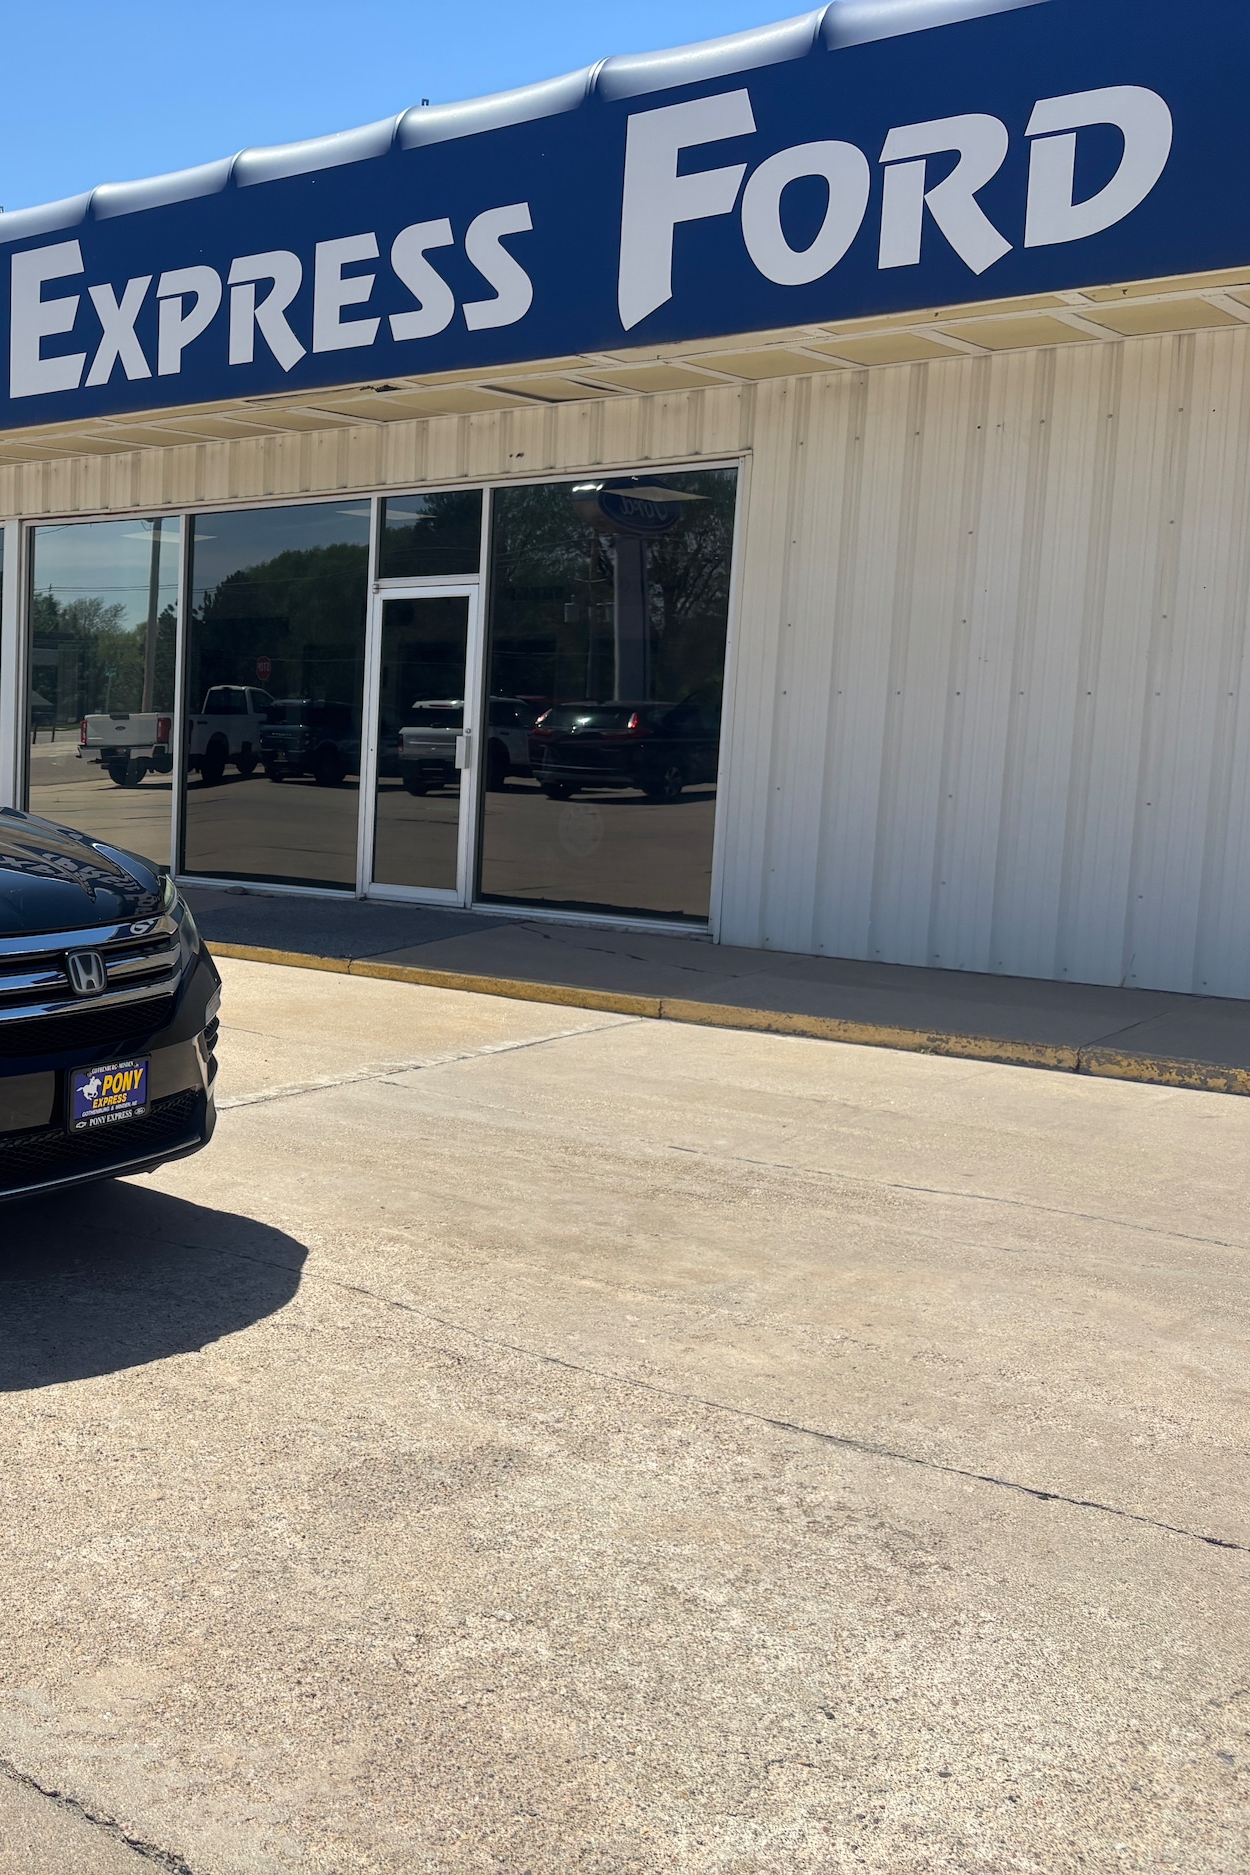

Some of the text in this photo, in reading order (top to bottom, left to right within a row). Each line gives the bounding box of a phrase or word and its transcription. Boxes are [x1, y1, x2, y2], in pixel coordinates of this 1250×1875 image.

[10, 201, 534, 399] EXPRESS
[618, 85, 1173, 331] FORD
[102, 1068, 144, 1096] PONY
[93, 1093, 127, 1109] EXPRESS
[89, 1115, 106, 1126] PONY
[106, 1109, 133, 1123] EXPRESS
